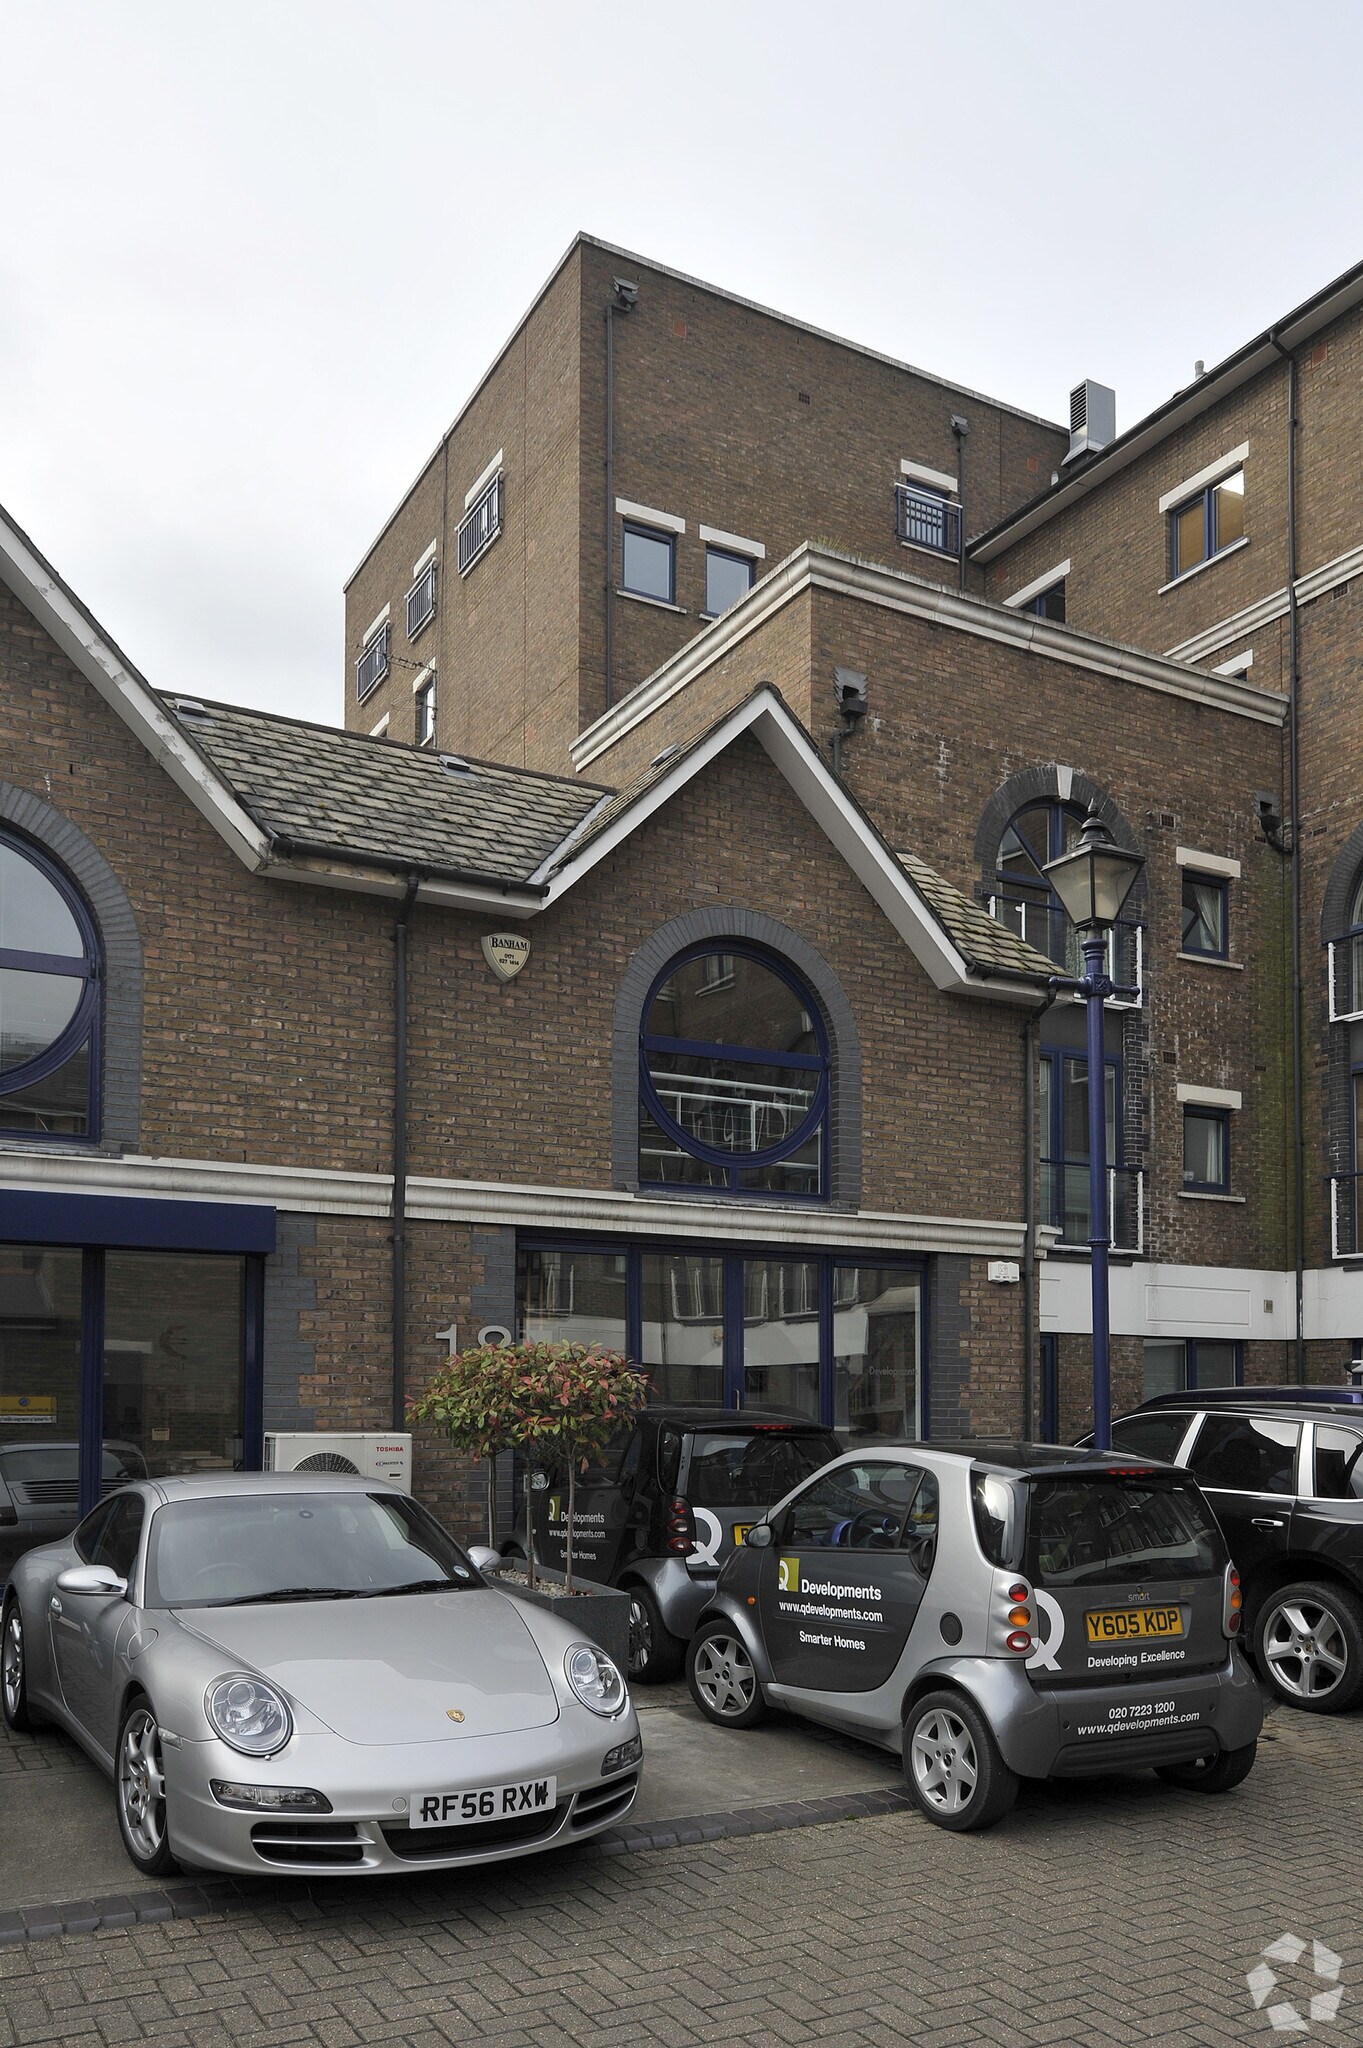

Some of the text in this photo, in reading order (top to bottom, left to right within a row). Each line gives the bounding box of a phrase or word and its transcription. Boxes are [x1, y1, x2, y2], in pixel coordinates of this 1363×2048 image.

[491, 937, 527, 949] BANHAM
[560, 1511, 605, 1525] Deelopments
[549, 1529, 606, 1539] www.qdelopments.com
[686, 1507, 722, 1566] Q
[560, 1549, 597, 1560] Smter Homes
[801, 1578, 882, 1600] Developments
[1127, 1592, 1150, 1602] smart
[778, 1601, 883, 1622] www.qdevelopments.com
[1025, 1588, 1064, 1671] Q
[1088, 1609, 1178, 1637] Y605 KDP
[799, 1630, 866, 1651] Smarter Homes
[1087, 1650, 1186, 1668] Developing Excellence
[1108, 1701, 1176, 1719] 020 7223 1200
[1077, 1712, 1200, 1736] www.qdevelopments.com
[422, 1781, 549, 1822] RF56 RXW
